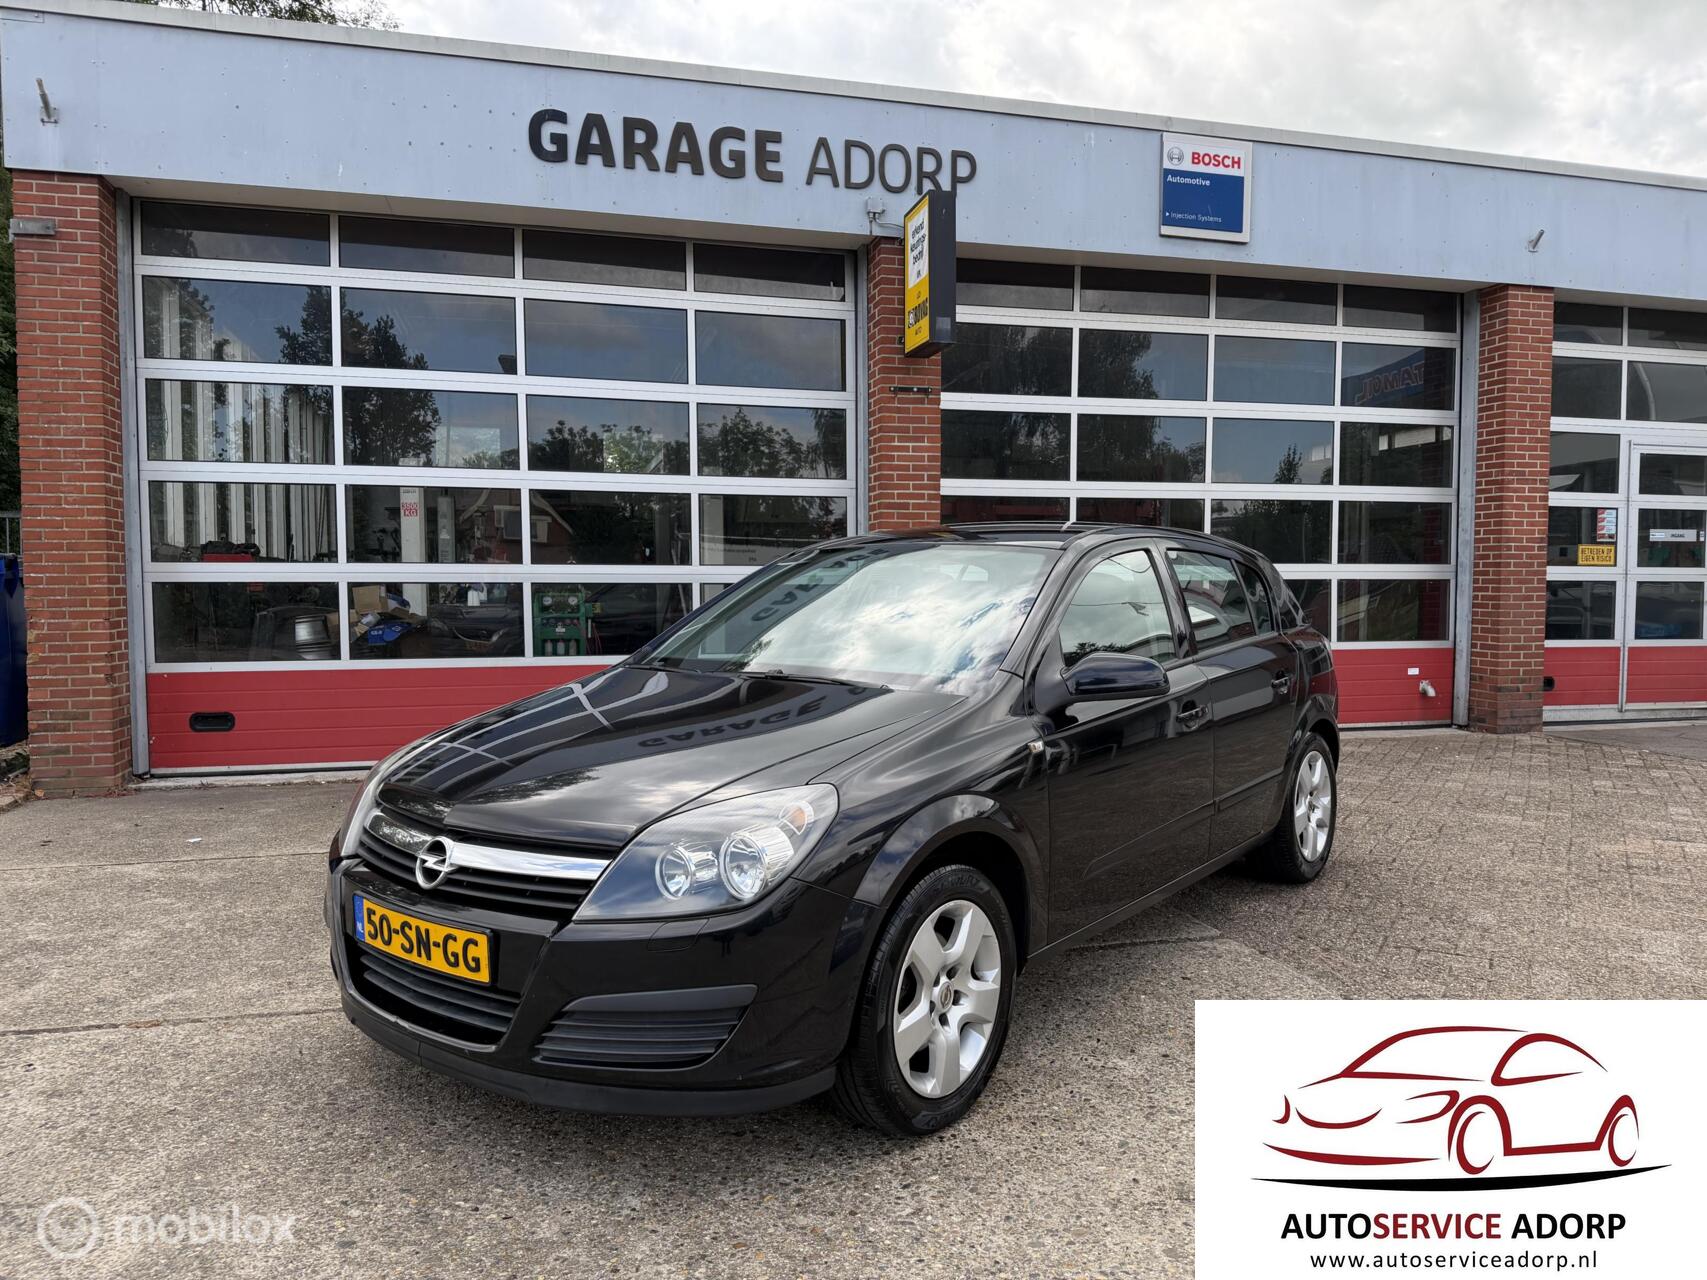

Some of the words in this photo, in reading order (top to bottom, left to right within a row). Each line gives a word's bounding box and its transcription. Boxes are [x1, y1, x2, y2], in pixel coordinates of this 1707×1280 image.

[528, 109, 784, 182] GARAGE
[805, 136, 977, 198] ADORP
[1191, 151, 1241, 169] BOSCH
[1166, 174, 1211, 186] Automotive
[1170, 211, 1196, 221] Injection
[1197, 214, 1222, 223] Systems
[404, 509, 418, 517] KG
[1580, 547, 1605, 555] BETREDEN
[1606, 547, 1613, 555] OP
[366, 907, 481, 973] 50-SN-GG
